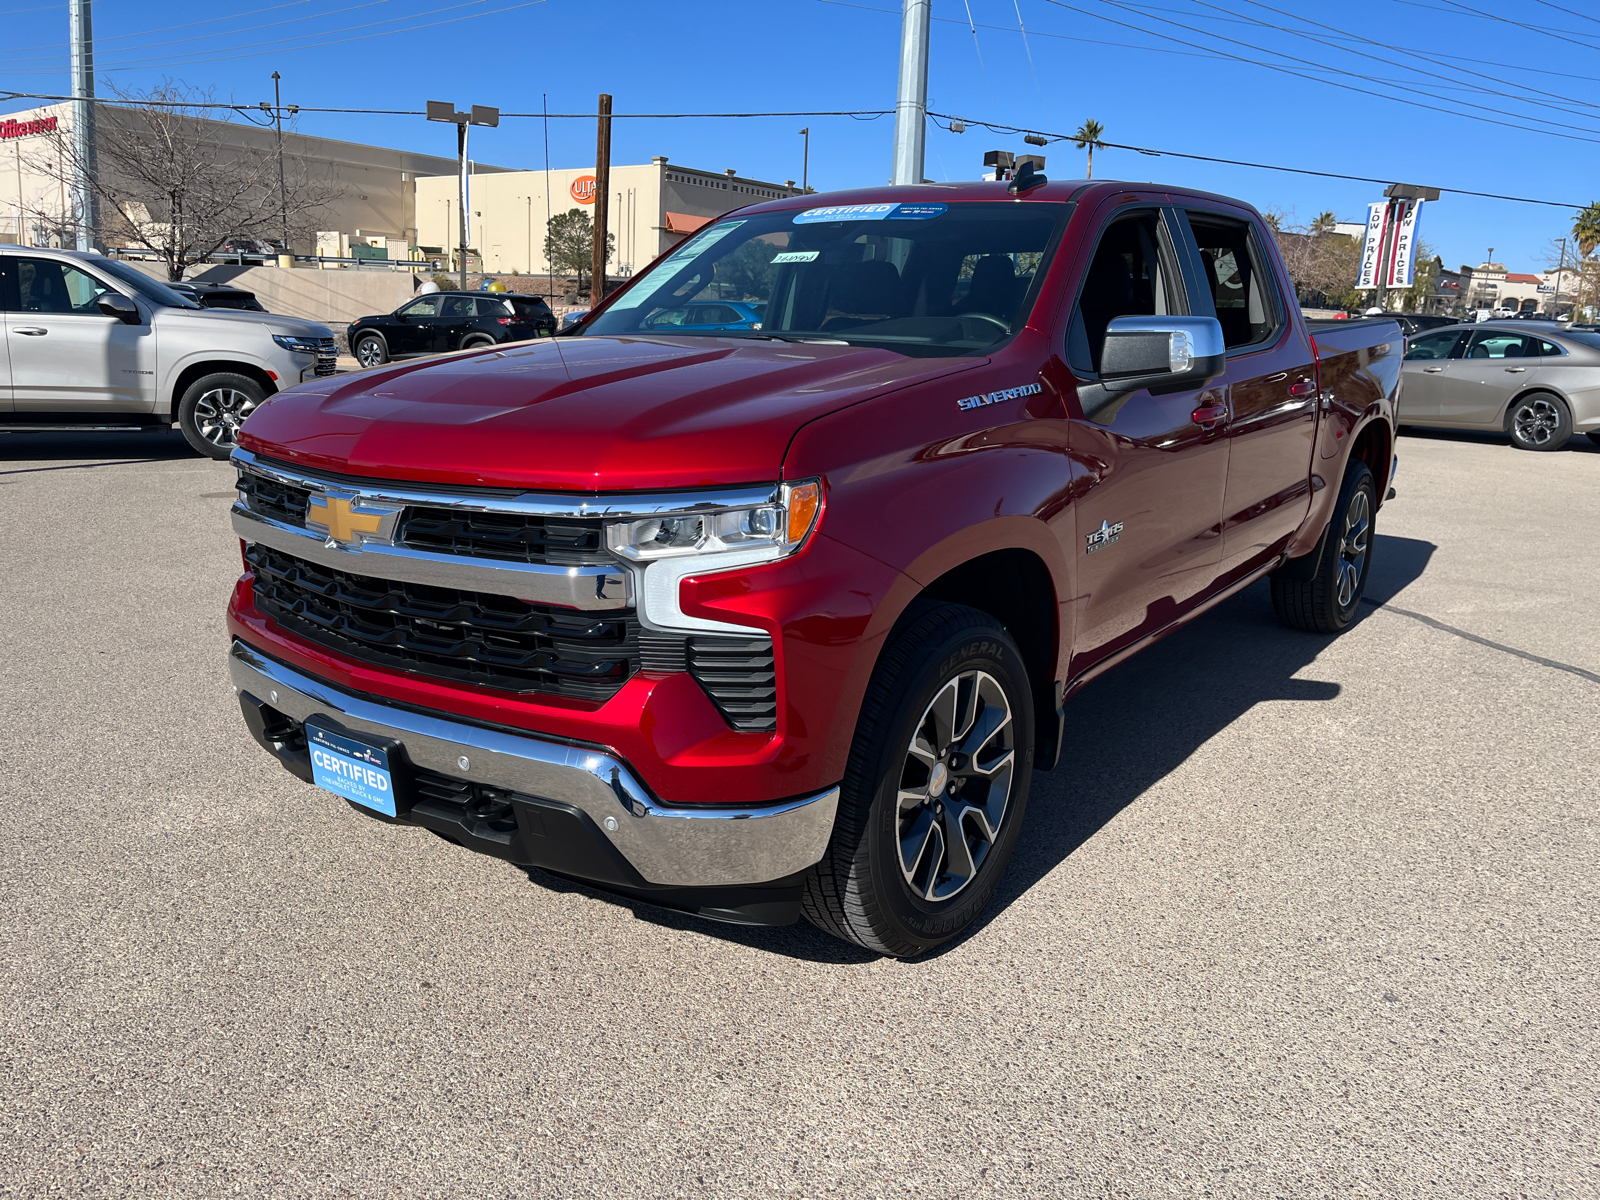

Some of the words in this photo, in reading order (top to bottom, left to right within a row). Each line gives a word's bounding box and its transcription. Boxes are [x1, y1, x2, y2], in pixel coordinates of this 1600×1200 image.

[803, 205, 890, 216] CERTIFIED
[1370, 206, 1380, 230] LOW
[1402, 203, 1413, 227] LOW
[1362, 238, 1375, 285] PRICES
[1396, 235, 1408, 284] PRICES
[957, 382, 1042, 411] SILVERADO
[1086, 520, 1123, 544] TEXAS
[940, 641, 1004, 678] GENERAL
[313, 750, 388, 791] CERTIFIED
[337, 776, 357, 788] BACKED
[321, 775, 350, 792] CHEVROLET
[352, 788, 367, 798] BUICK
[373, 796, 385, 805] GMC
